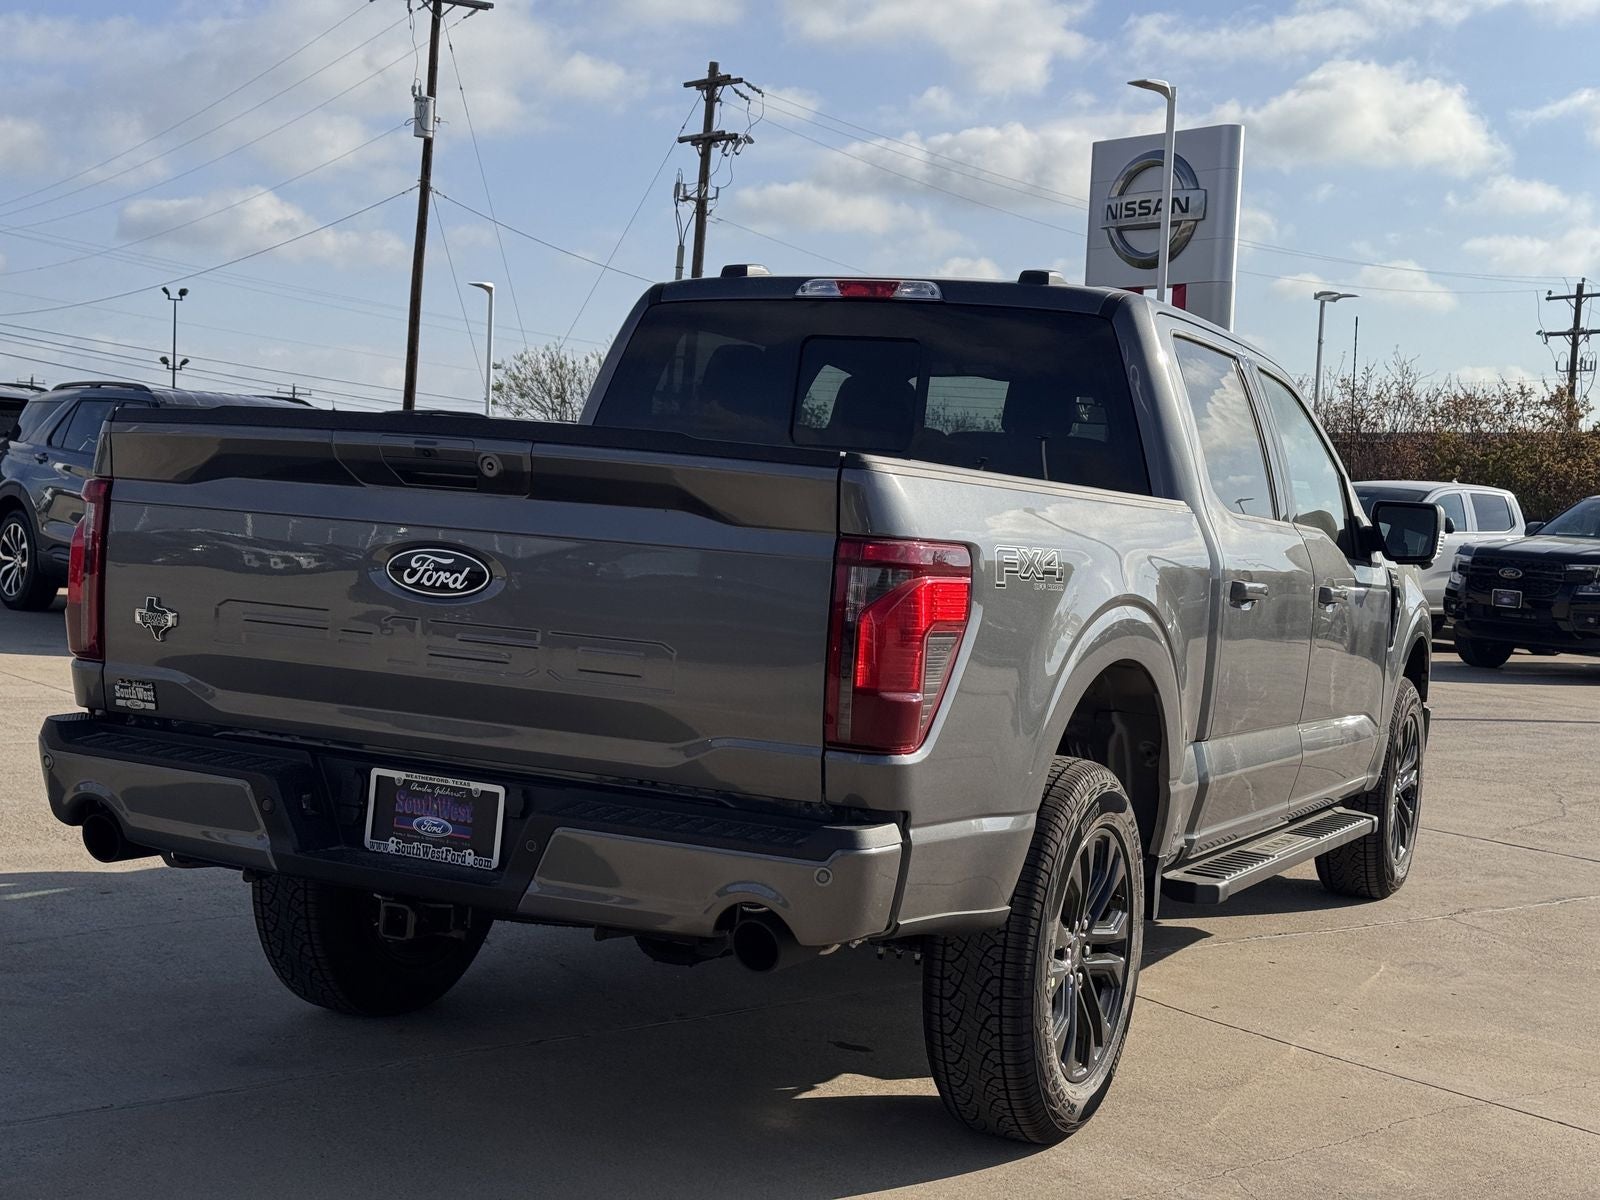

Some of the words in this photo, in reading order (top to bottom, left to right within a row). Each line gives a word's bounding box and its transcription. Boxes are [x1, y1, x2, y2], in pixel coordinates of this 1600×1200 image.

[1106, 196, 1190, 220] NISSAN
[403, 554, 471, 589] Ford
[994, 545, 1064, 589] FX4
[138, 611, 169, 625] TEXAS
[452, 779, 471, 788] TEXAS
[420, 819, 443, 834] Ford
